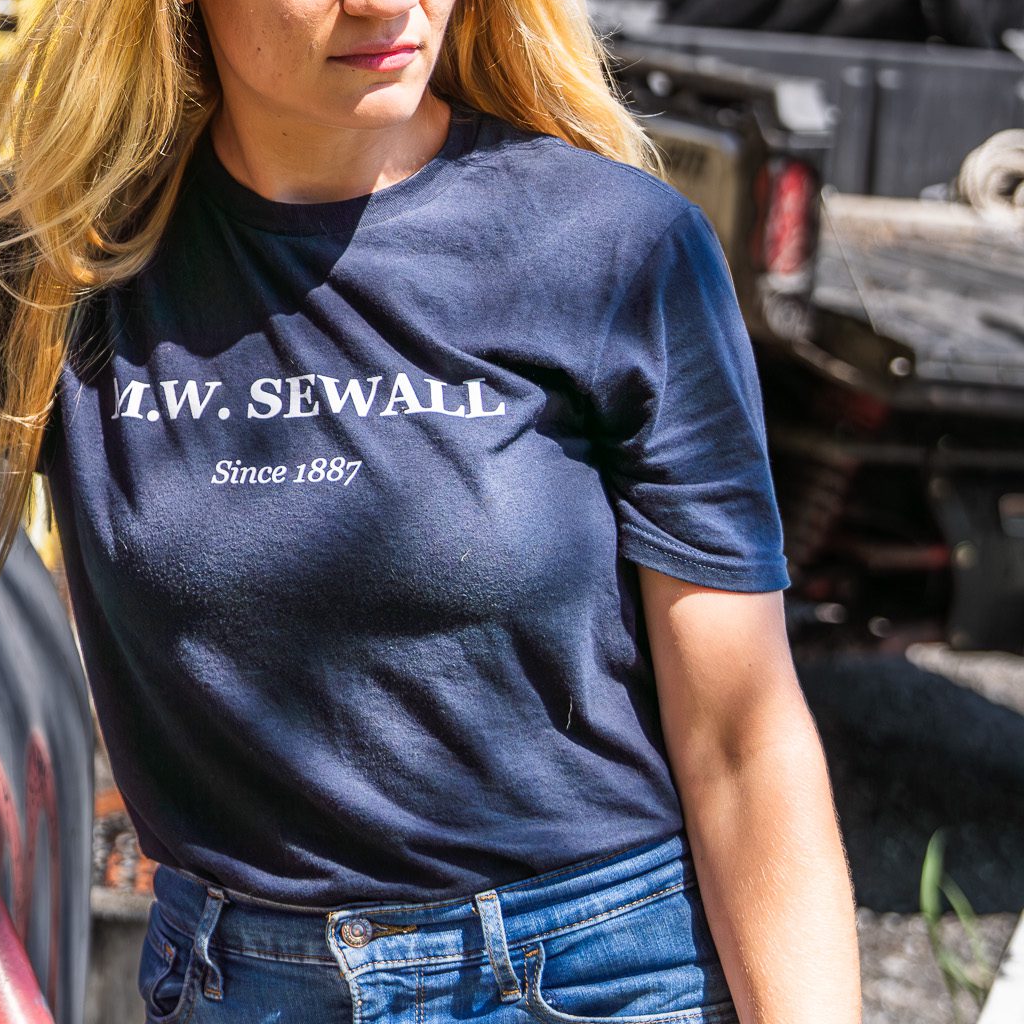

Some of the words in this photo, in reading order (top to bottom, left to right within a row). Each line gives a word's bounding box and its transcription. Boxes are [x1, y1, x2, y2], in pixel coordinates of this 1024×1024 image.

[111, 378, 230, 421] M.W.
[248, 372, 506, 419] SEWALL
[211, 459, 287, 484] Since
[293, 457, 362, 486] 1887
